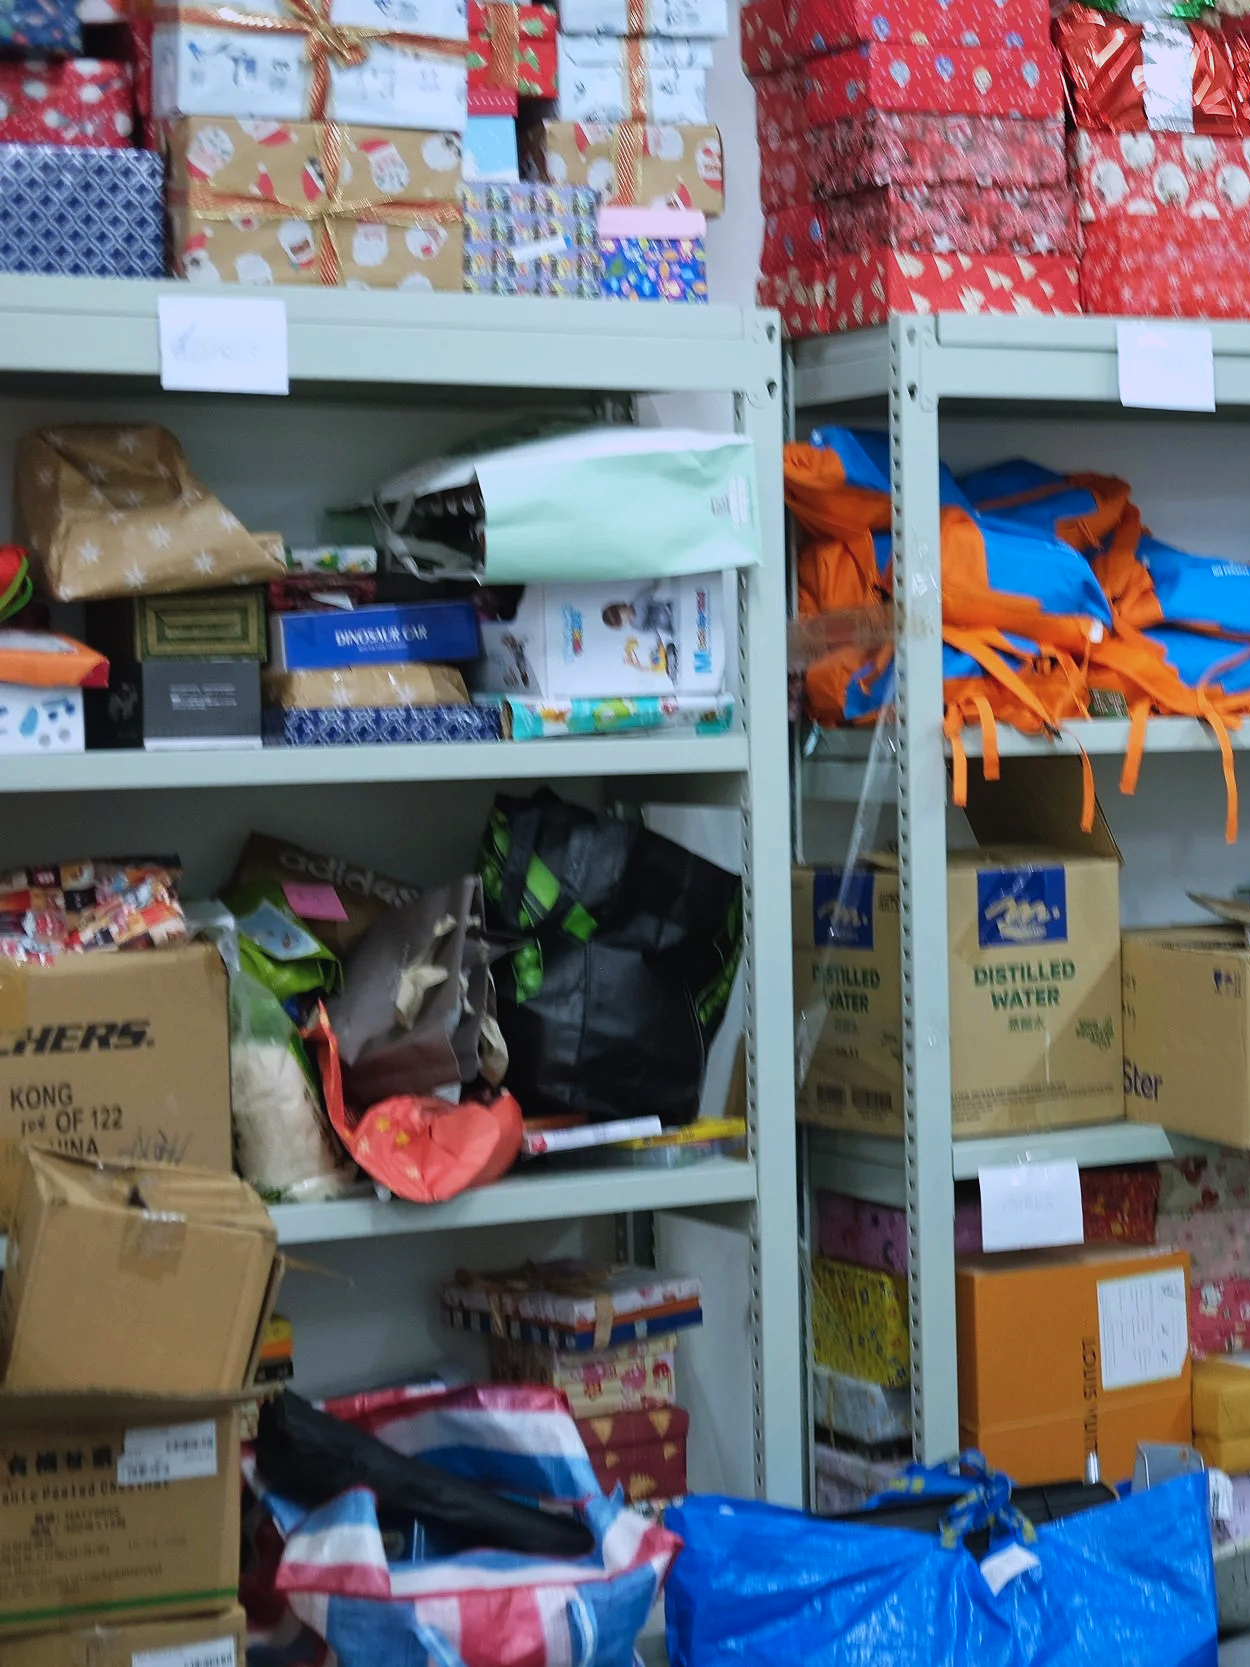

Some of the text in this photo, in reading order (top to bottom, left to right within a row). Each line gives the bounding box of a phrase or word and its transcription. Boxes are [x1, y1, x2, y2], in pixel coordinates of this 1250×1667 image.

[335, 624, 428, 647] DINOSAUR CAR
[974, 958, 1076, 987] DISTILLED
[990, 985, 1061, 1011] WATER
[10, 1081, 73, 1113] KONG
[55, 1102, 123, 1135] OF 122
